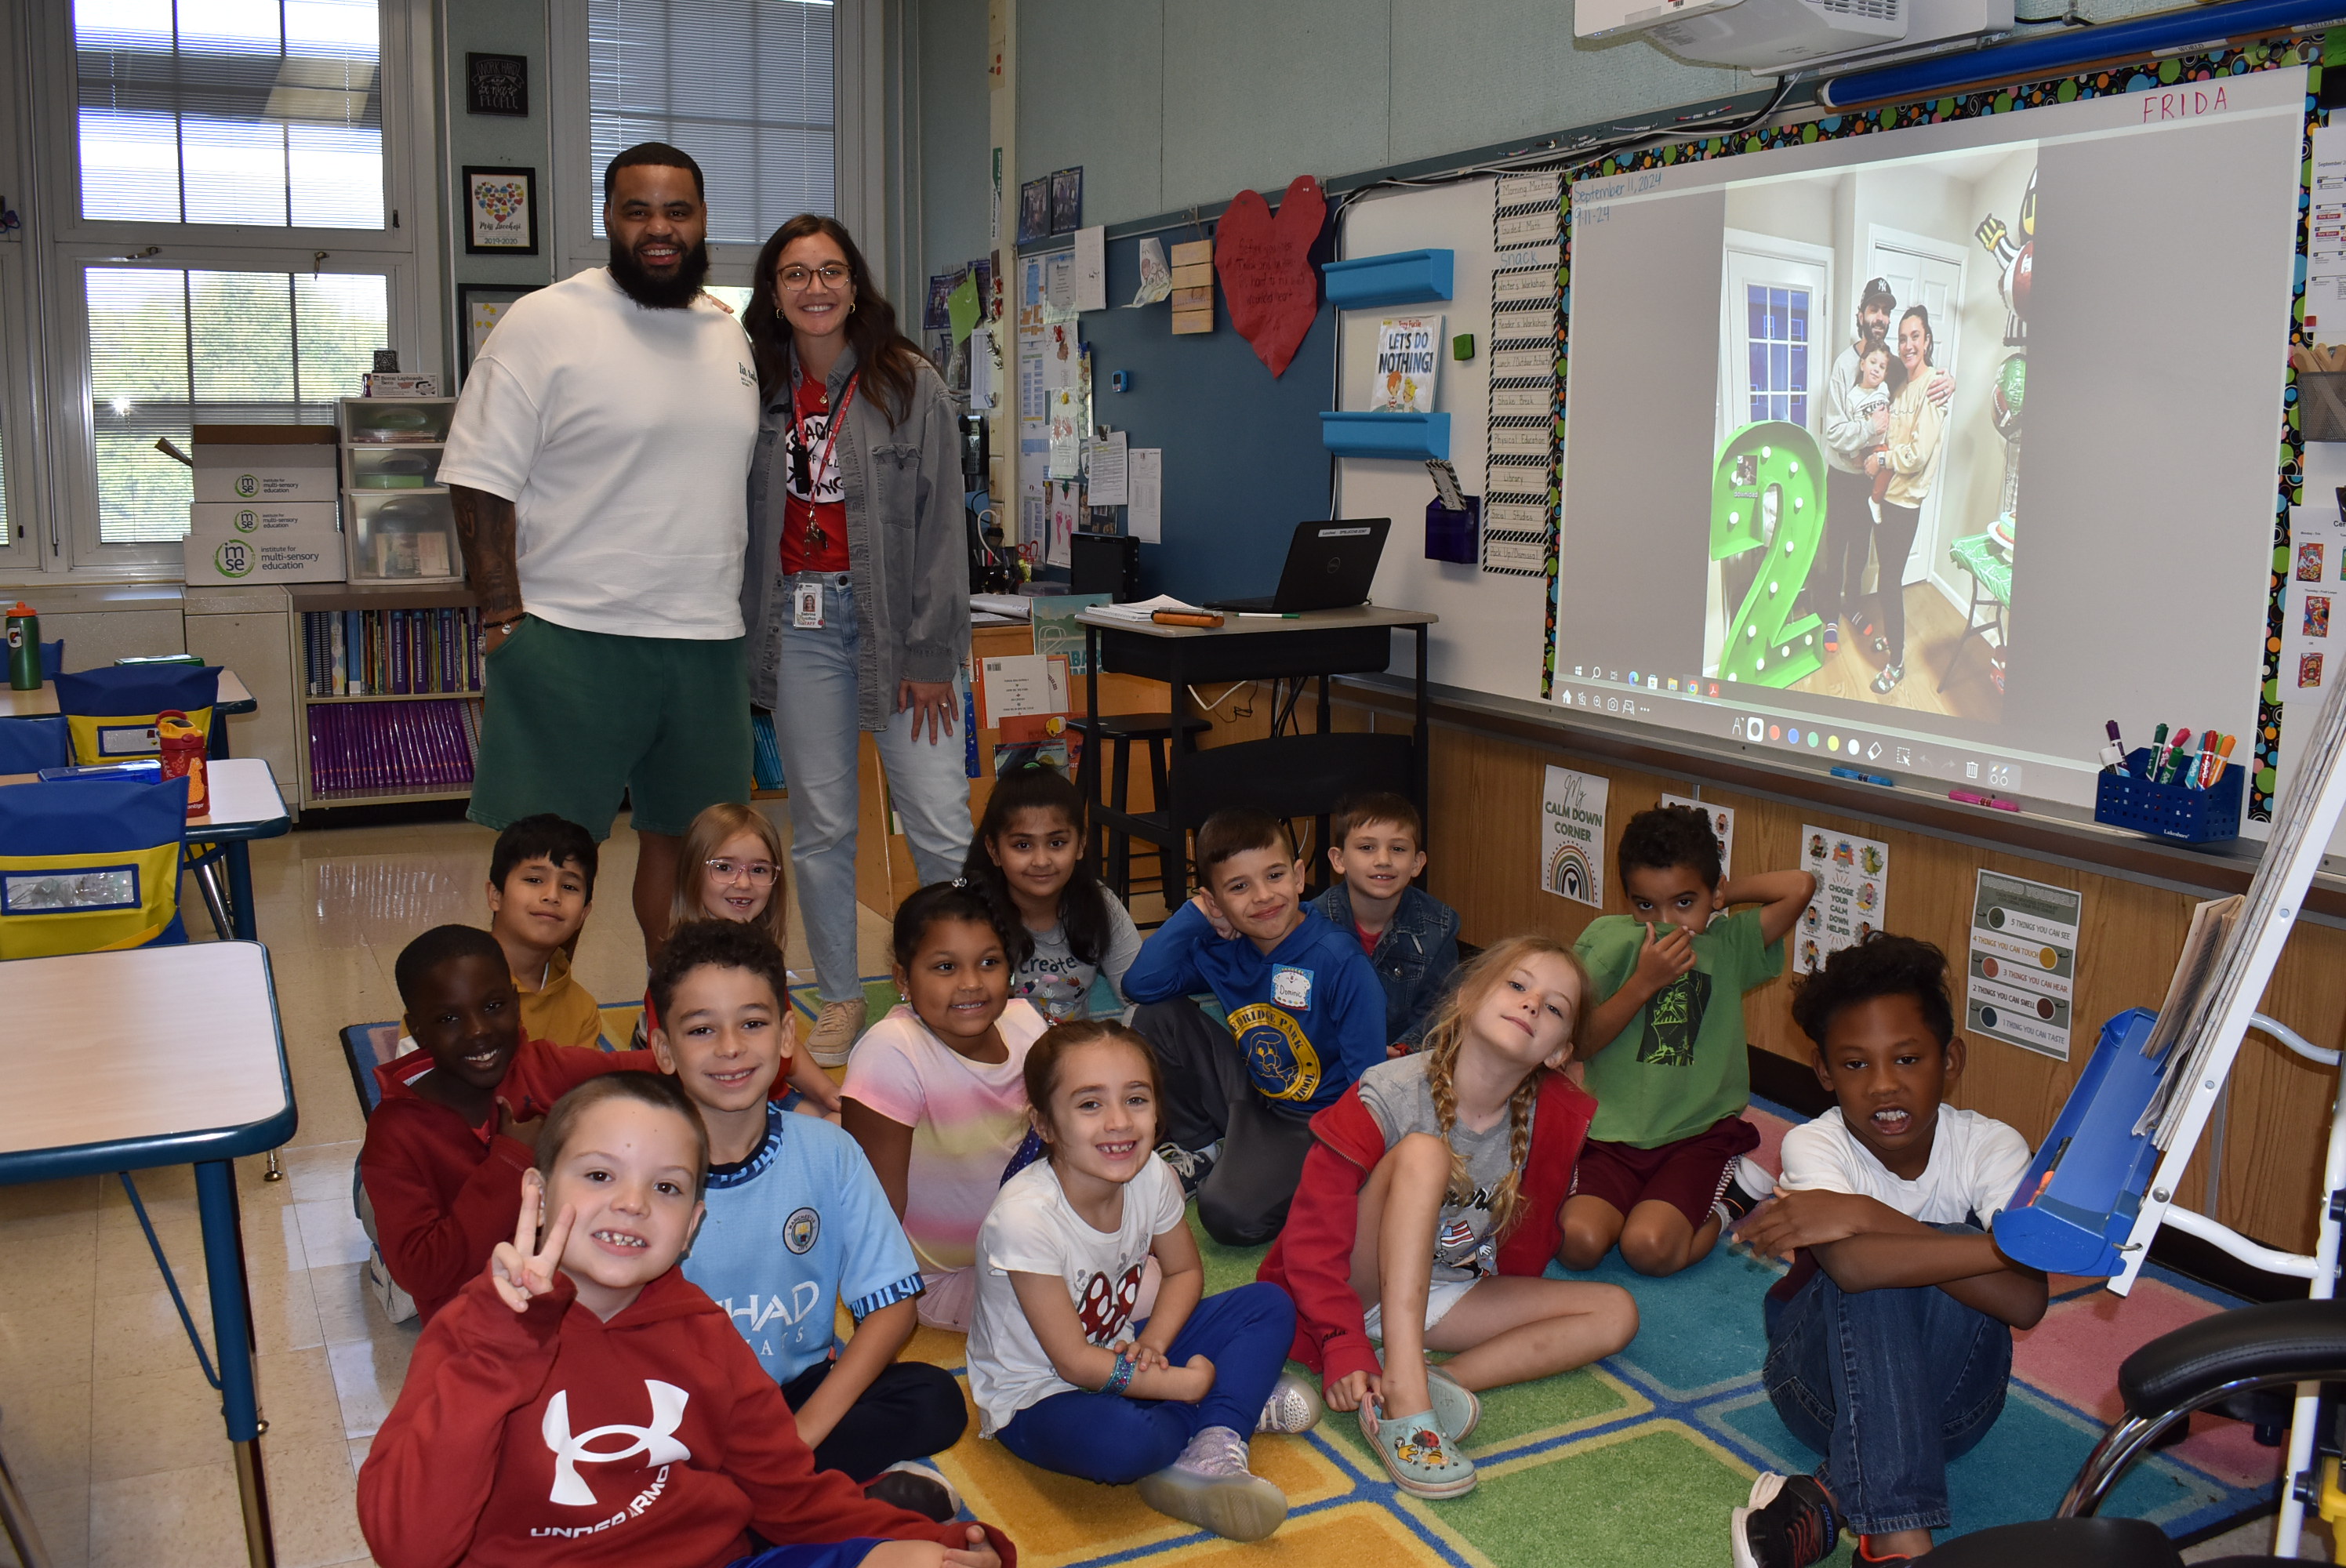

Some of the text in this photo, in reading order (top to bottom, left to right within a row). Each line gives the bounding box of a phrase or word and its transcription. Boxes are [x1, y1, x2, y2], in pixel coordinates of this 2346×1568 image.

[477, 61, 518, 76] WORK HARD
[2144, 87, 2227, 123] FRIDA
[1502, 180, 1552, 198] Morning Meeting
[1573, 182, 1625, 205] September
[1502, 220, 1541, 234] Guided Math
[1522, 279, 1546, 290] Workshop
[1523, 317, 1548, 328] Workshop
[1389, 332, 1429, 350] LET'S DO
[1378, 352, 1434, 374] NOTHING!
[1494, 433, 1545, 446] Physical Education
[1504, 475, 1523, 486] Library
[1491, 509, 1533, 521] Social Studies
[261, 553, 319, 561] multi-sensory
[262, 561, 303, 570] education
[1564, 775, 1587, 811] My
[1545, 801, 1603, 828] CALM DOWN
[1554, 821, 1592, 843] CORNER
[1828, 884, 1854, 897] CHOOSE
[1981, 875, 2025, 895] GROUND
[2025, 885, 2077, 908] YOURSELF
[1831, 894, 1848, 906] YOUR
[1830, 904, 1848, 916] CALM
[1828, 914, 1849, 926] DOWN
[1826, 923, 1850, 937] HELPER
[2017, 920, 2036, 931] THINGS
[2036, 925, 2047, 935] YOU
[2048, 928, 2060, 938] CAN
[2061, 931, 2071, 941] SEE
[1978, 936, 1996, 947] THINGS
[1998, 941, 2009, 951] YOU
[2009, 945, 2020, 954] CAN
[2021, 947, 2039, 959] TOUCH
[2008, 970, 2028, 982] THINGS
[2028, 975, 2040, 985] YOU
[2040, 979, 2052, 989] CAN
[2053, 983, 2068, 993] HEAR
[1280, 984, 1302, 998] Dominic
[1978, 985, 1996, 997] THINGS
[1997, 991, 2008, 1000] YOU
[2009, 995, 2020, 1004] CAN
[2021, 998, 2036, 1010] SMELL
[1280, 1018, 1304, 1051] PARK
[2006, 1020, 2023, 1032] THING
[2024, 1025, 2035, 1035] YOU
[2036, 1029, 2046, 1040] CAN
[2047, 1033, 2065, 1045] TASTE
